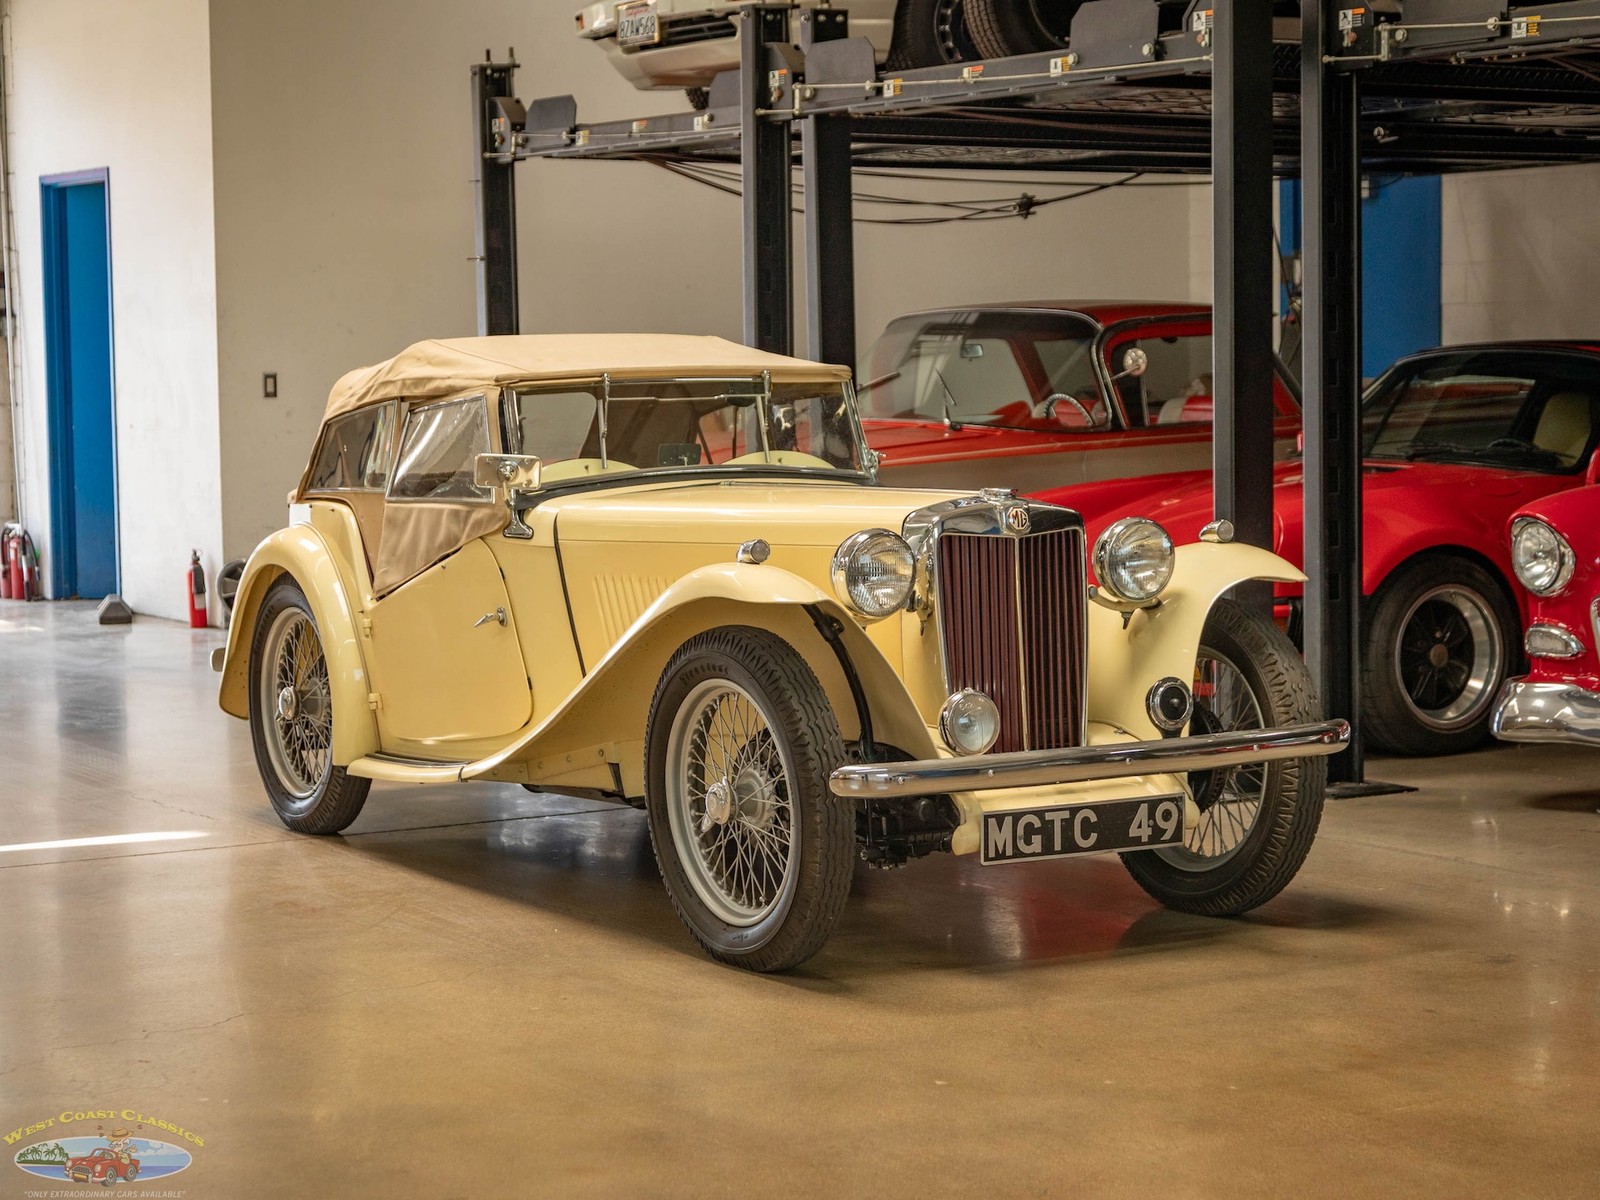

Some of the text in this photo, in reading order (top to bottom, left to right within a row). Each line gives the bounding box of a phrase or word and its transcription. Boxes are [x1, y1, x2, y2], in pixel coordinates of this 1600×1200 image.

[1012, 510, 1027, 528] MG
[988, 801, 1179, 858] MGTC 49
